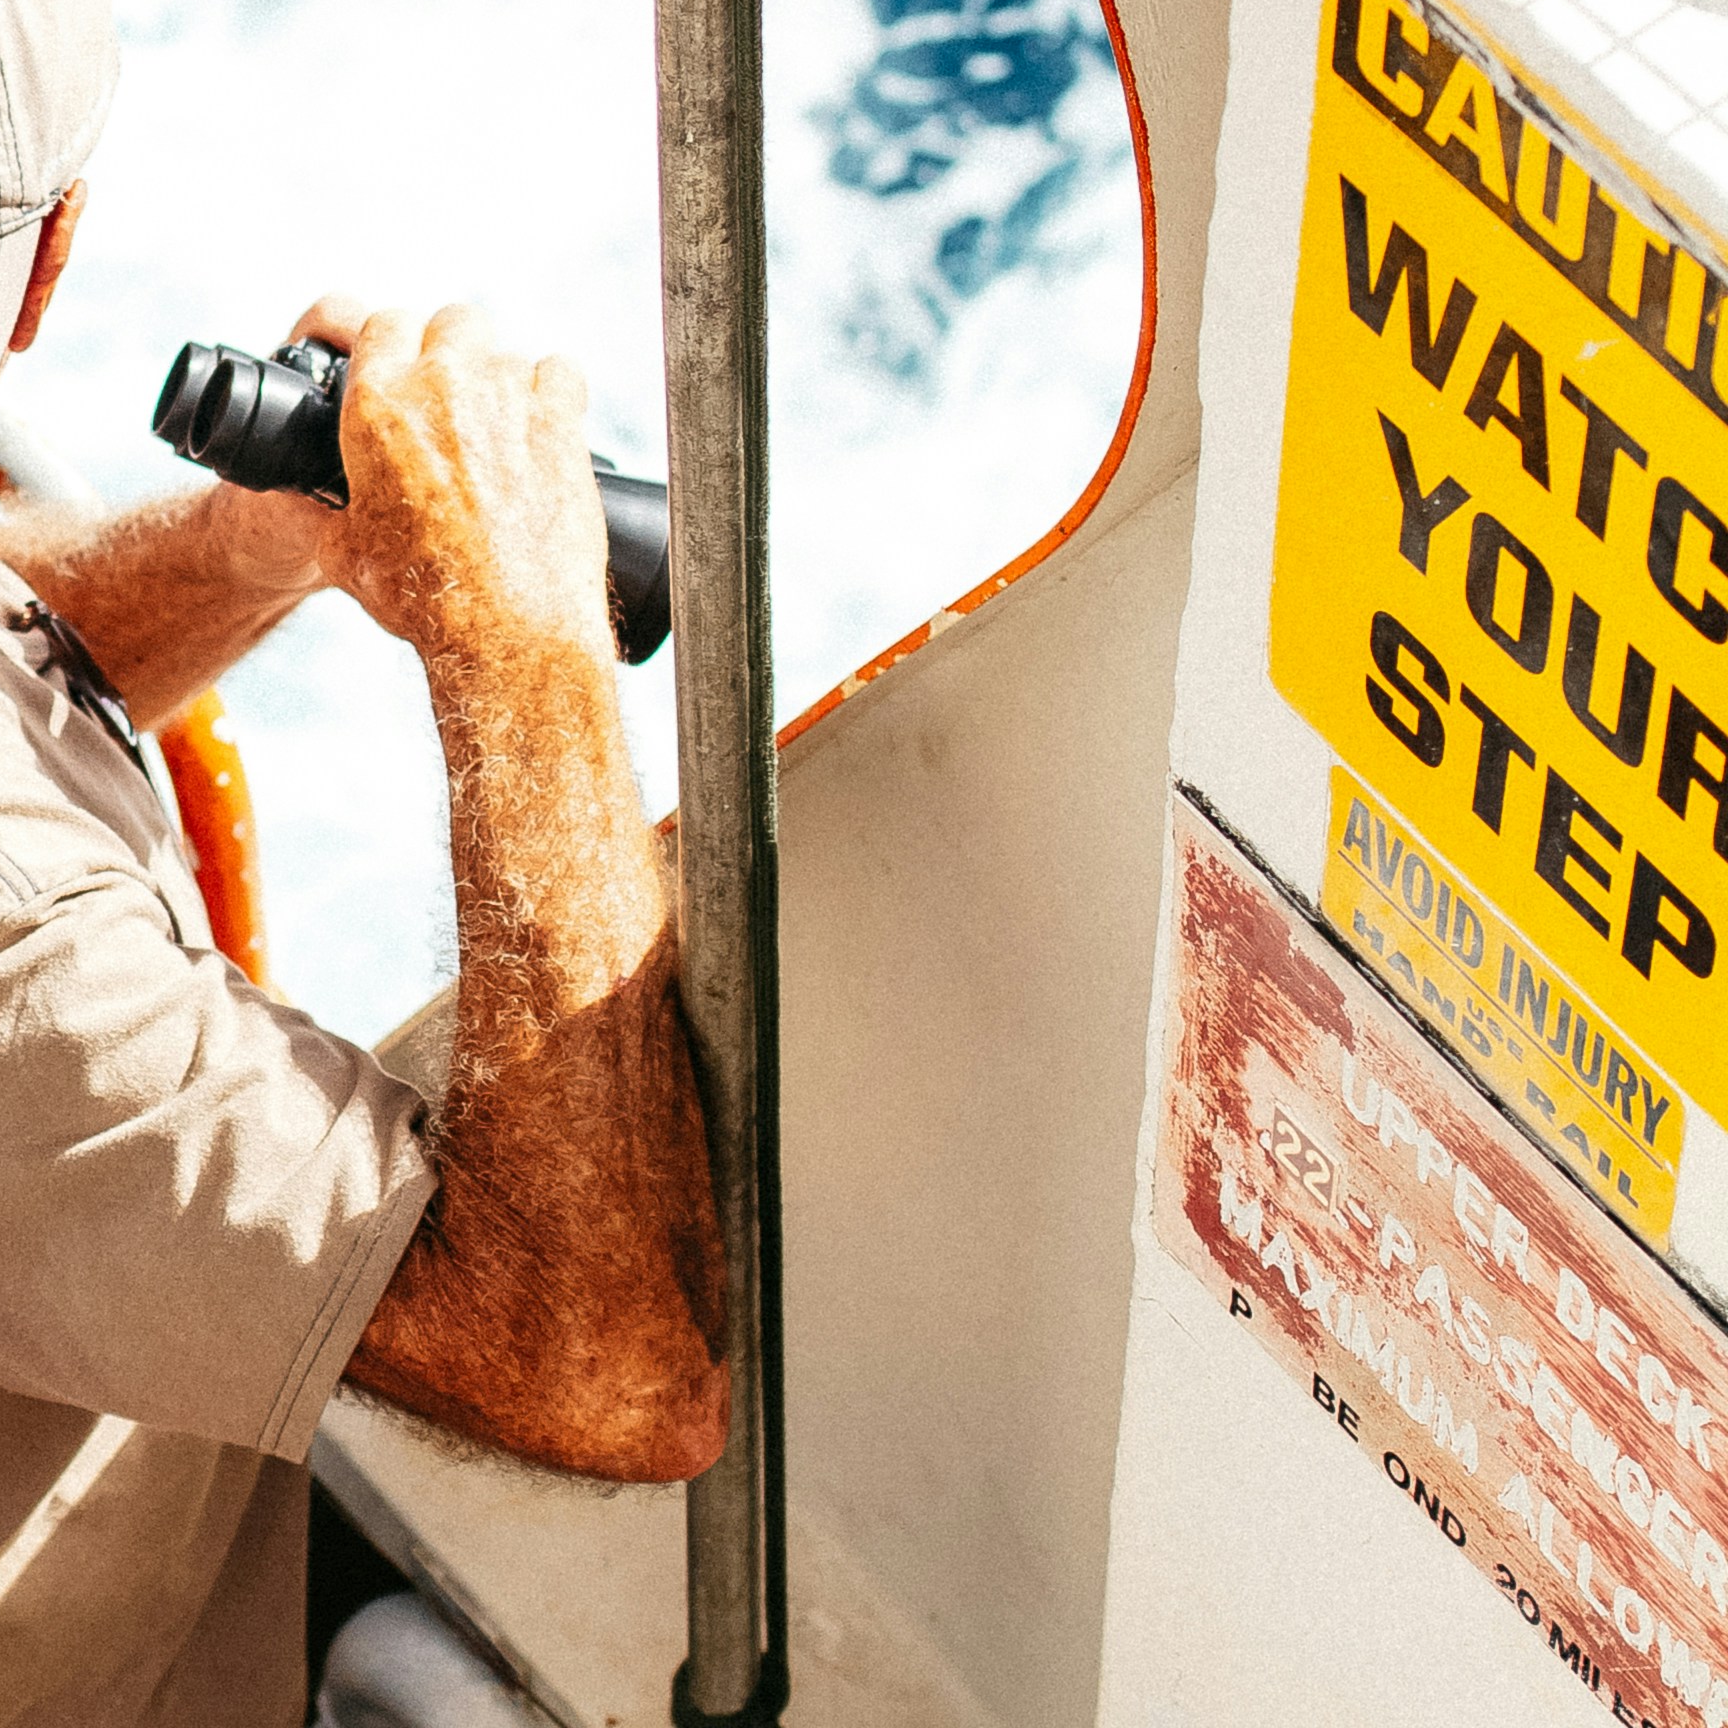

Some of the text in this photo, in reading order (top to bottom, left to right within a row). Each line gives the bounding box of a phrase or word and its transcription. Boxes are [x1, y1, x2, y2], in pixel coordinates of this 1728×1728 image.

[1366, 610, 1716, 980] STEP
[1377, 408, 1728, 864] YOUR
[1342, 797, 1671, 1147] AVOID INJURY
[1353, 908, 1639, 1209] HAND RAIL
[1220, 1171, 1479, 1476] MAXIMUM
[1272, 1119, 1333, 1209] 22
[1341, 1045, 1713, 1471] UPPER DECK
